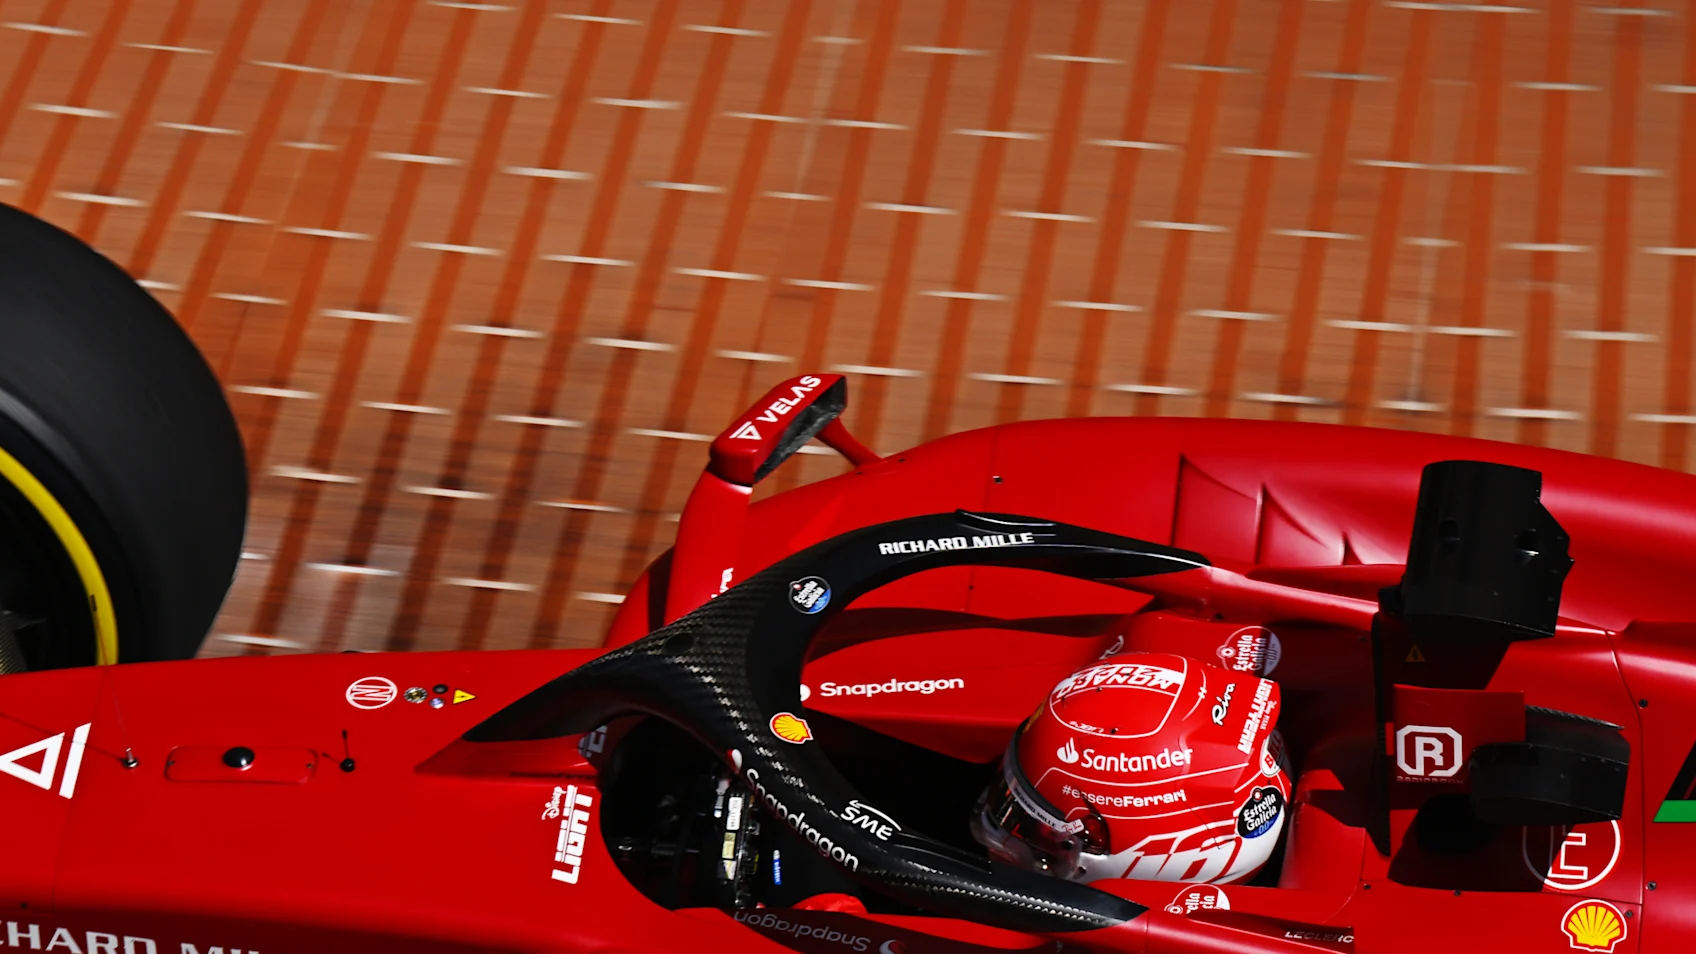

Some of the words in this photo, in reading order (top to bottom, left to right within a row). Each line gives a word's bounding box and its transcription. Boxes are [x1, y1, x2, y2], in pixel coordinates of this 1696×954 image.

[757, 376, 821, 423] VELAS
[879, 537, 968, 555] RICHARD
[972, 532, 1035, 549] MILLE
[821, 679, 964, 697] Snapdragon
[1081, 748, 1193, 772] Santander
[1061, 784, 1187, 808] #essereFerrari
[1243, 793, 1277, 822] Estrella
[1246, 807, 1278, 832] Galicia
[733, 911, 872, 951] Snapdragon
